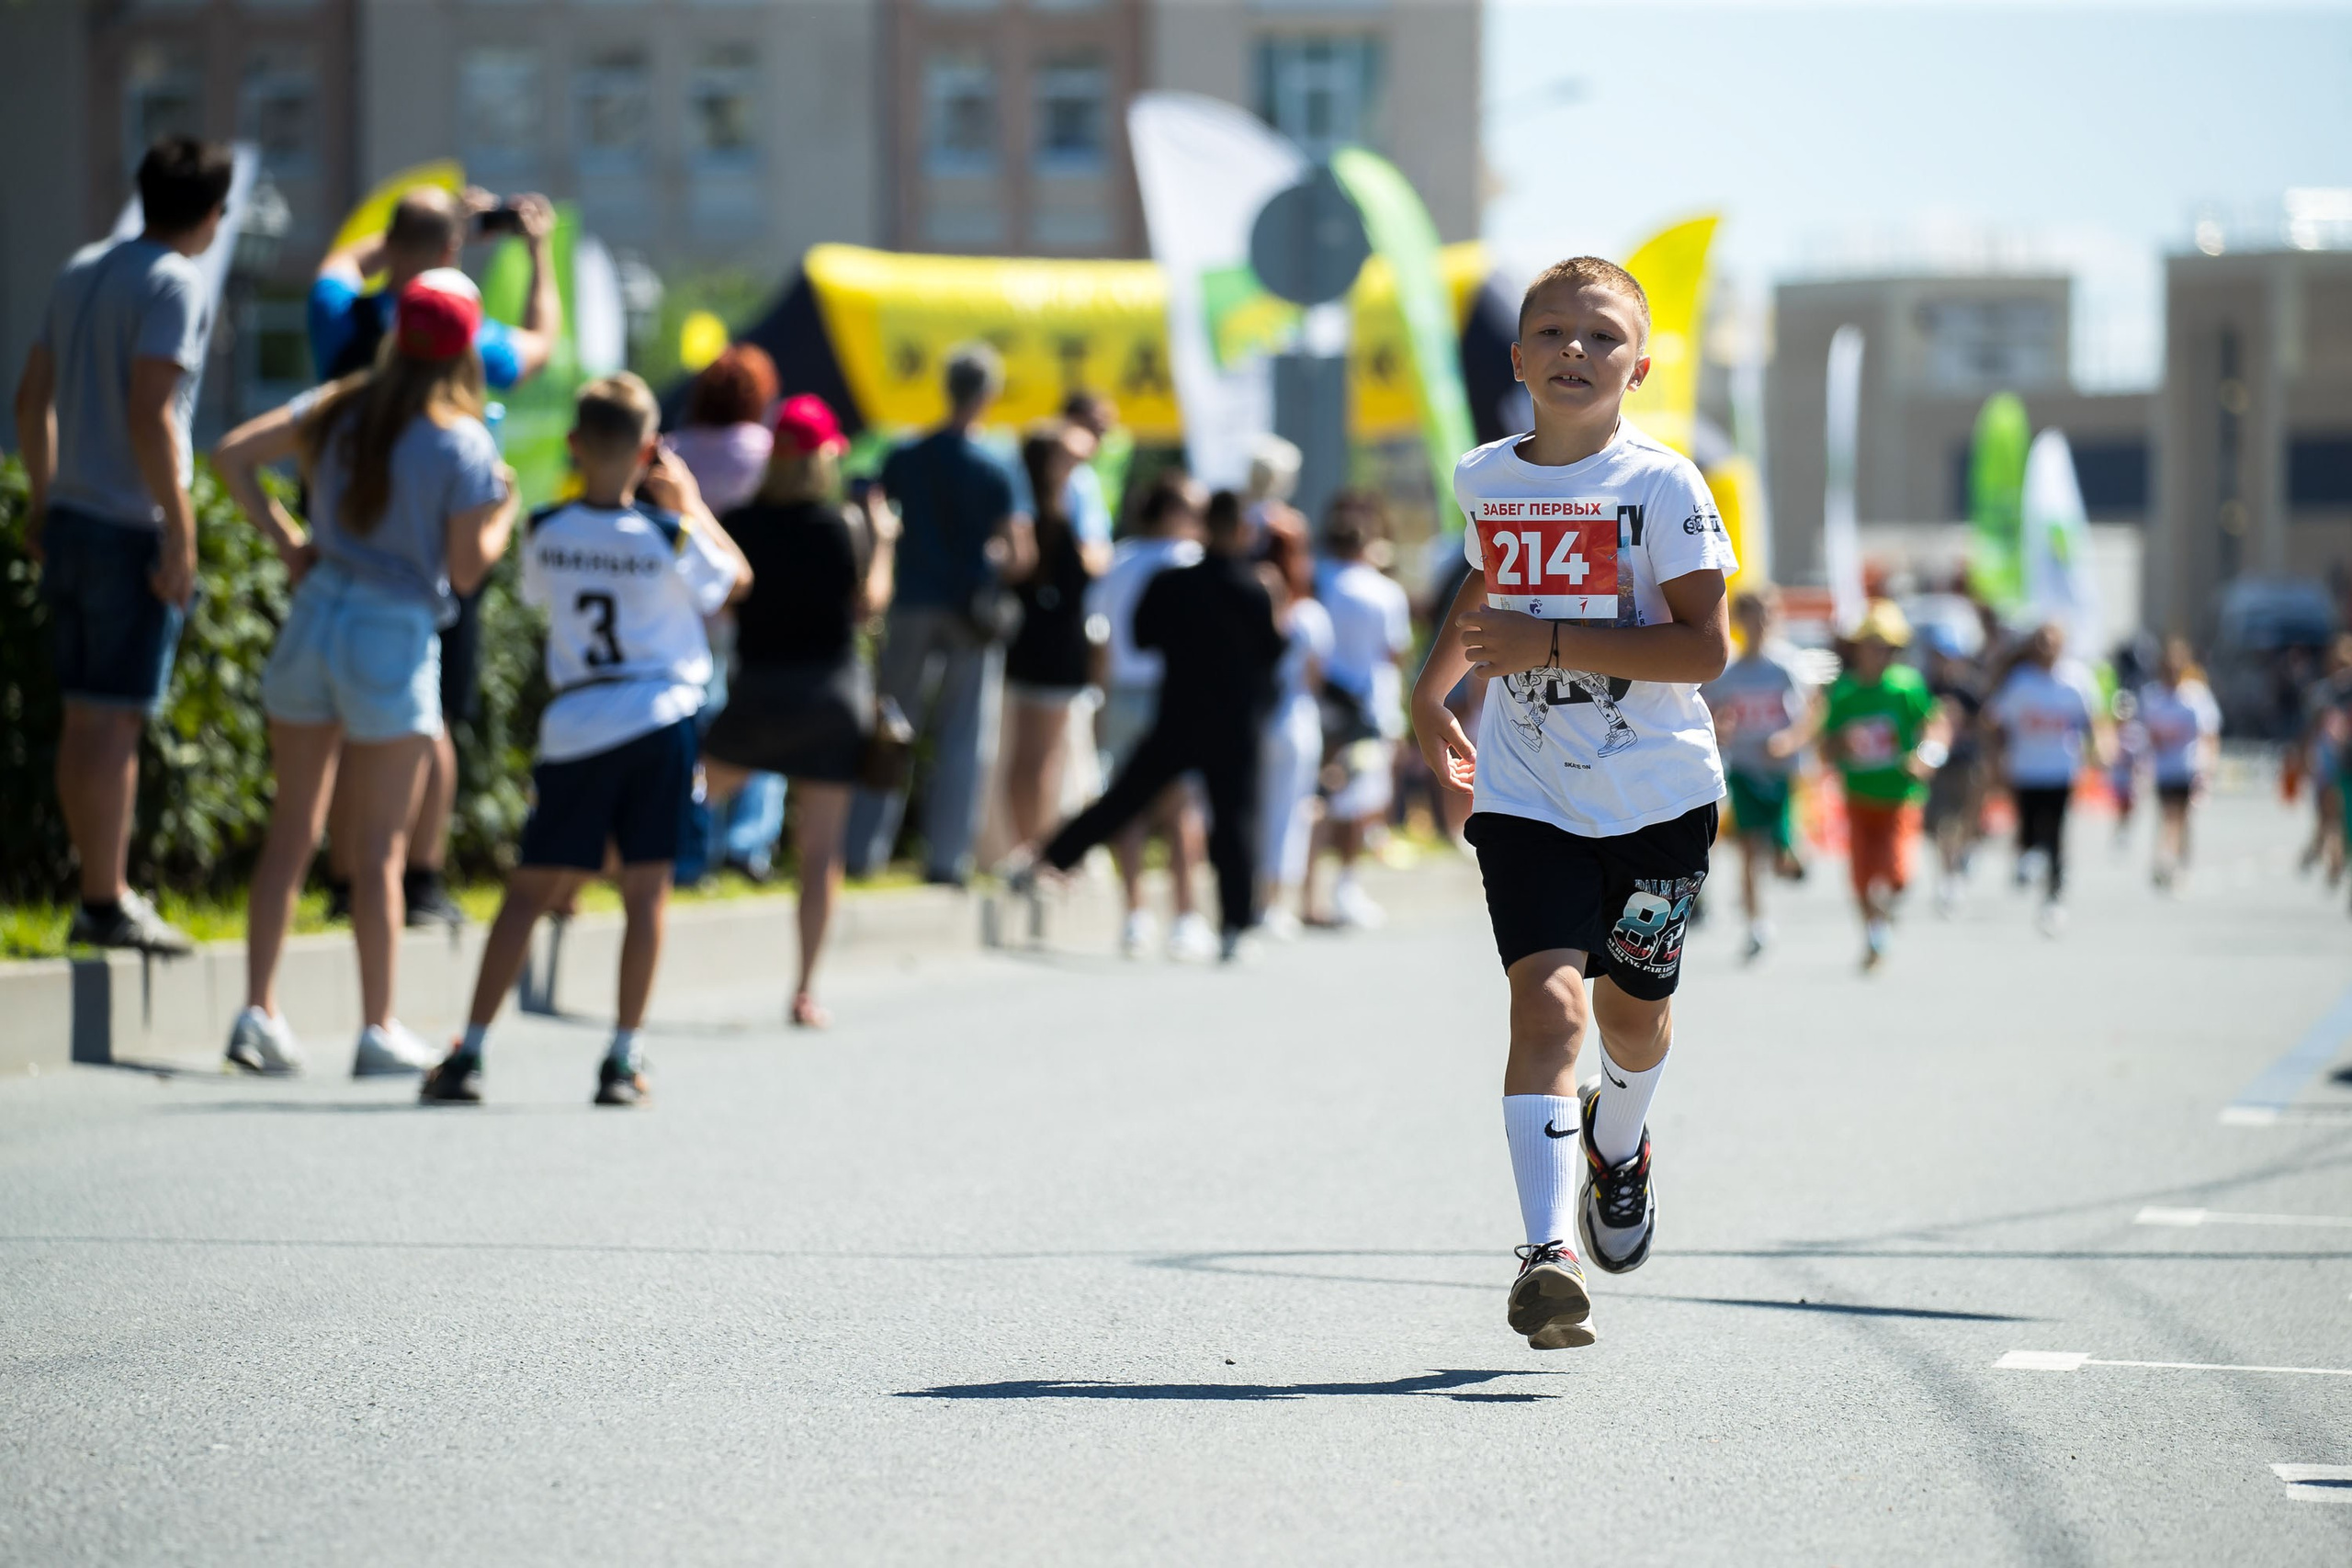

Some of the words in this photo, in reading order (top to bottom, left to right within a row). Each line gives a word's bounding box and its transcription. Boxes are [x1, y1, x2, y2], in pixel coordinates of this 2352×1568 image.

[1483, 503, 1525, 516] ЗАБЕГ
[1529, 502, 1602, 515] ПЕРВЫХ
[1492, 530, 1590, 585] 214
[575, 588, 626, 671] 3
[1611, 891, 1694, 966] 82
